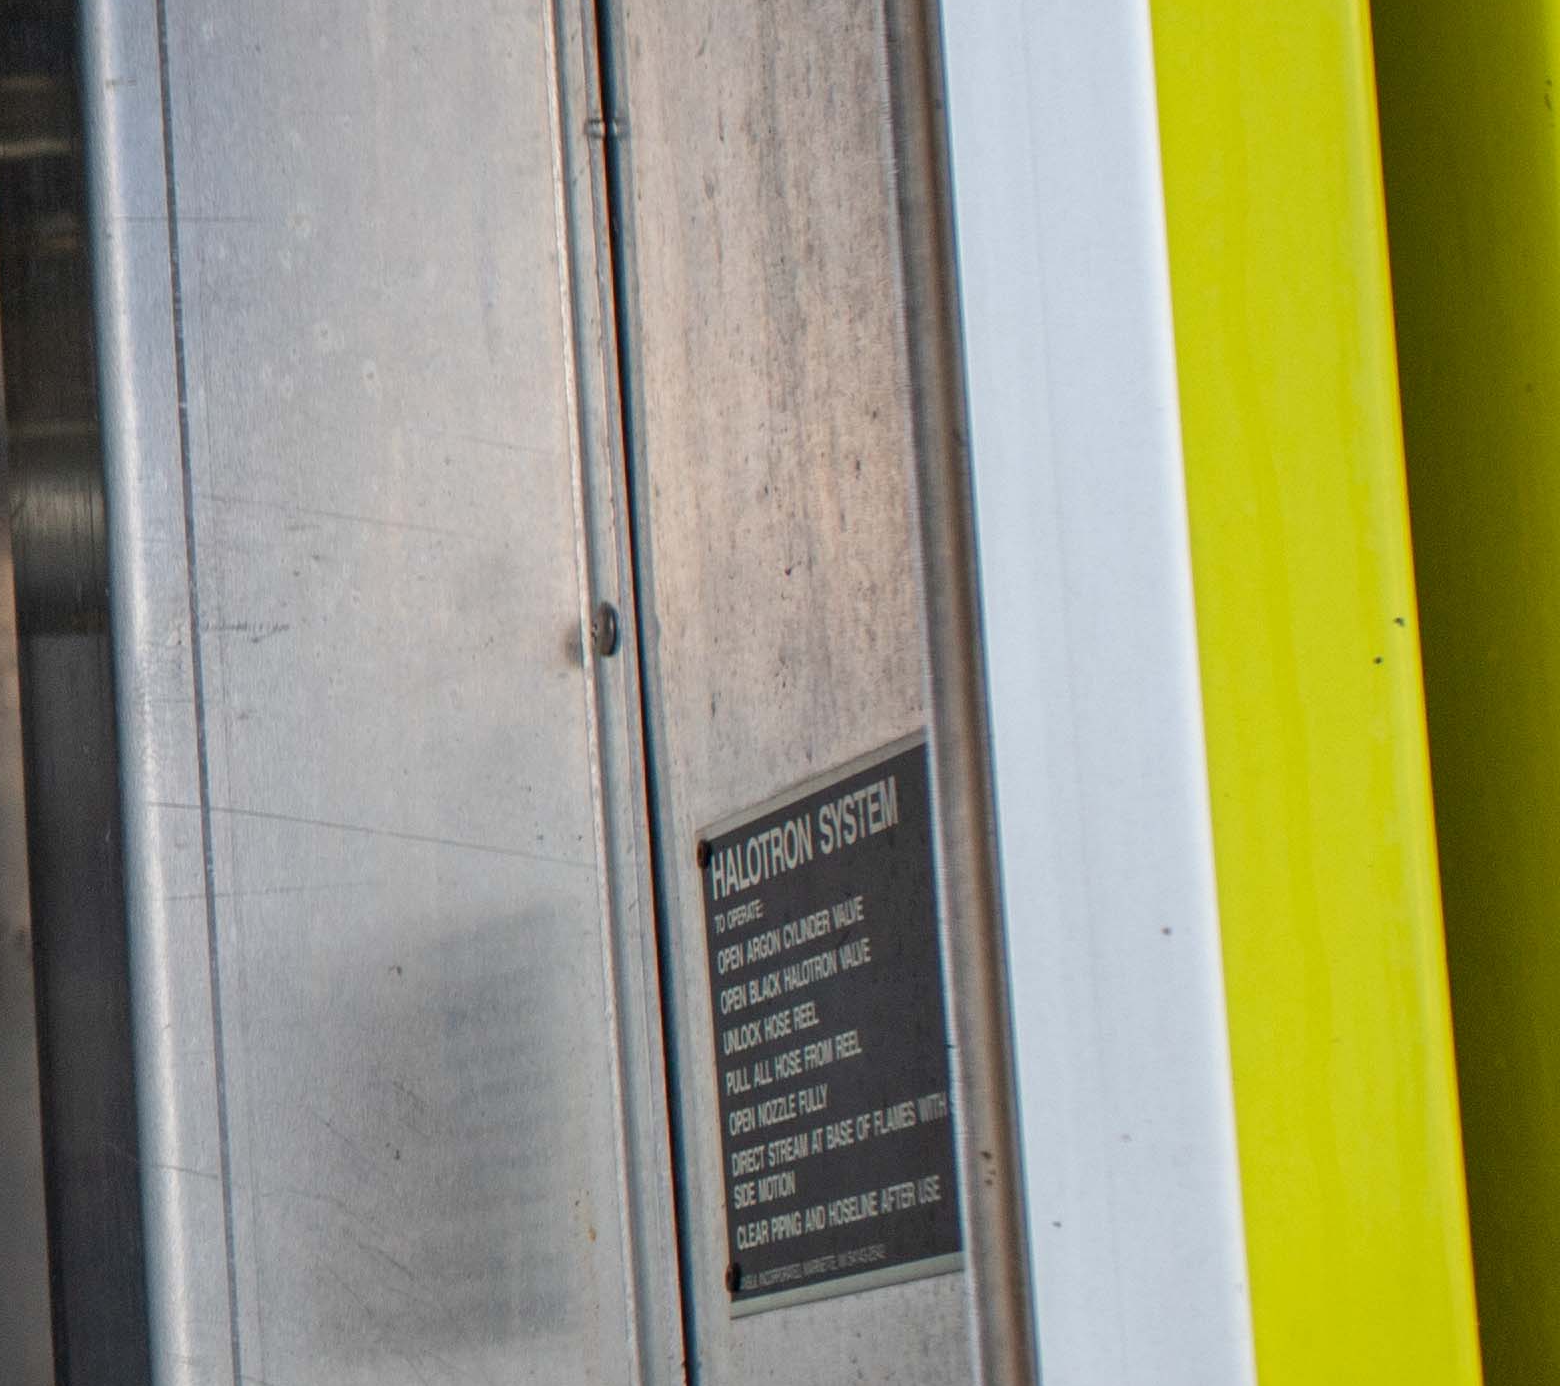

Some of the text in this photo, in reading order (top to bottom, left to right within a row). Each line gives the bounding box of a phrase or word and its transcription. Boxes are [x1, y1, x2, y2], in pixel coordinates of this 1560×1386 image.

[711, 776, 899, 901] HALOTRON SYSTEM
[717, 895, 864, 975] OPEN ARGON CYLINDER VALVE
[720, 937, 871, 1015] OPEN BLACK HALOTRON VALVE
[722, 1001, 820, 1056] UNLOCK HOSE REEL
[726, 1029, 862, 1096] PULL ALL HOSE FROM REEL
[729, 1082, 829, 1137] OPEN NOZZLE FULLY
[731, 1091, 948, 1177] DIRECT STREAM AT BASE OF FLAMES WITH
[734, 1170, 796, 1210] SIDE MOTION
[737, 1175, 942, 1251] CLEAR PIPING AND HOSELINE AFTER USE
